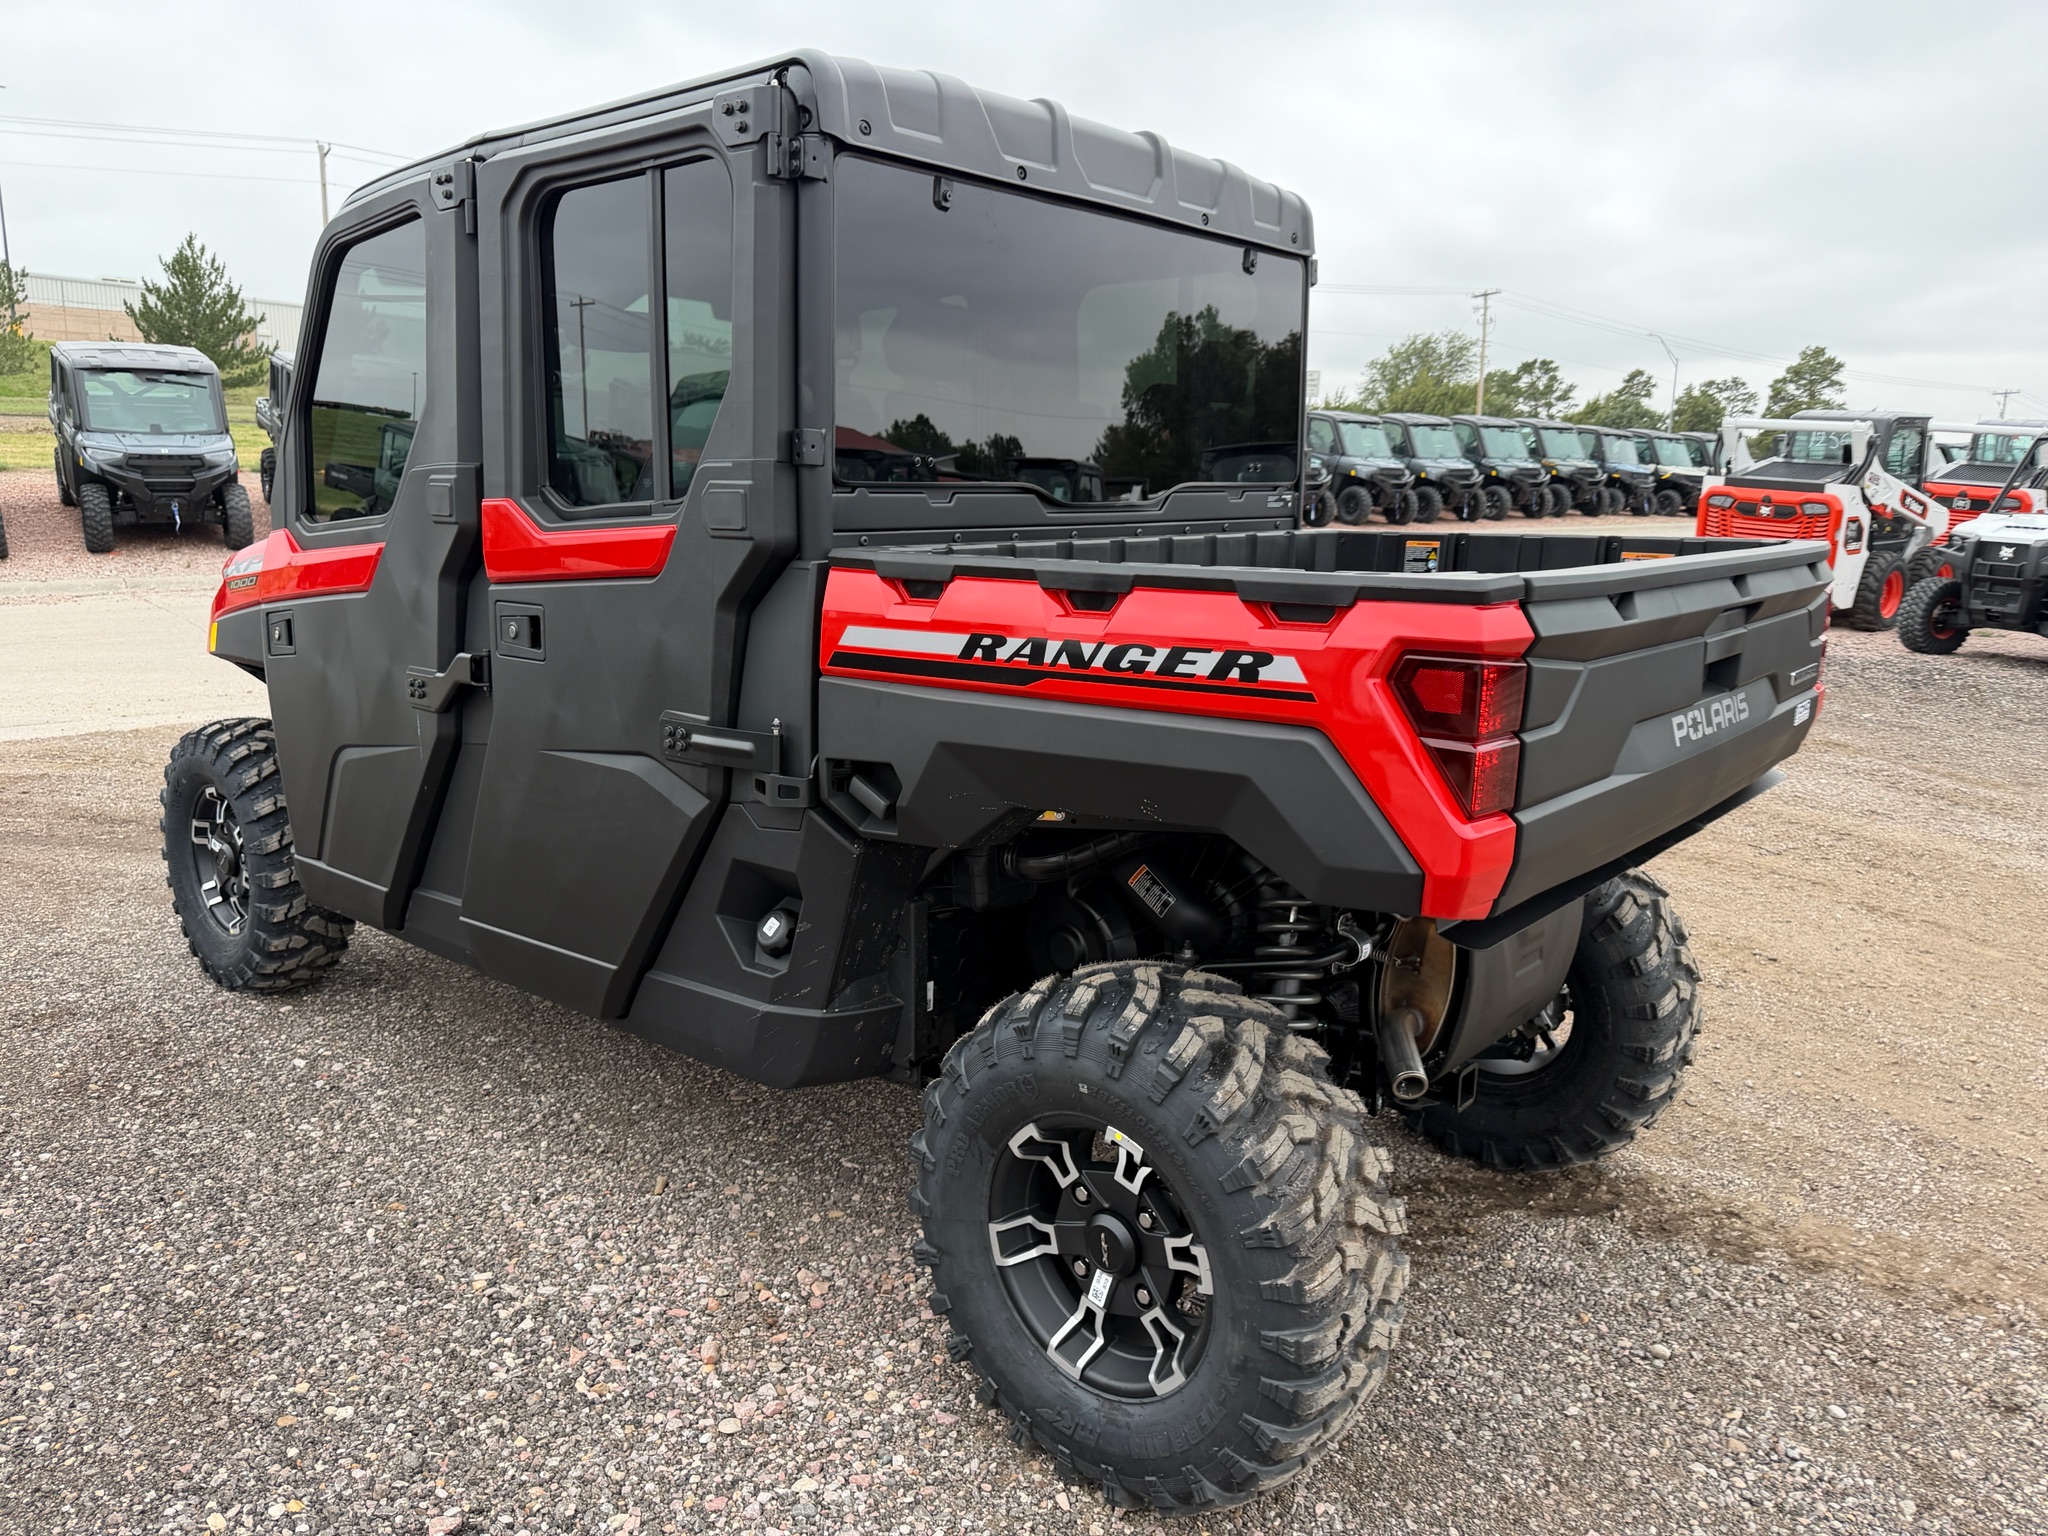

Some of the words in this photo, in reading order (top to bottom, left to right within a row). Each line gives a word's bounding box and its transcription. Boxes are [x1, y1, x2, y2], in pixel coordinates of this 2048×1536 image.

[230, 576, 257, 590] 1000
[957, 632, 1275, 684] RANGER
[1671, 691, 1749, 747] POLARIS
[946, 1131, 970, 1178] PRO
